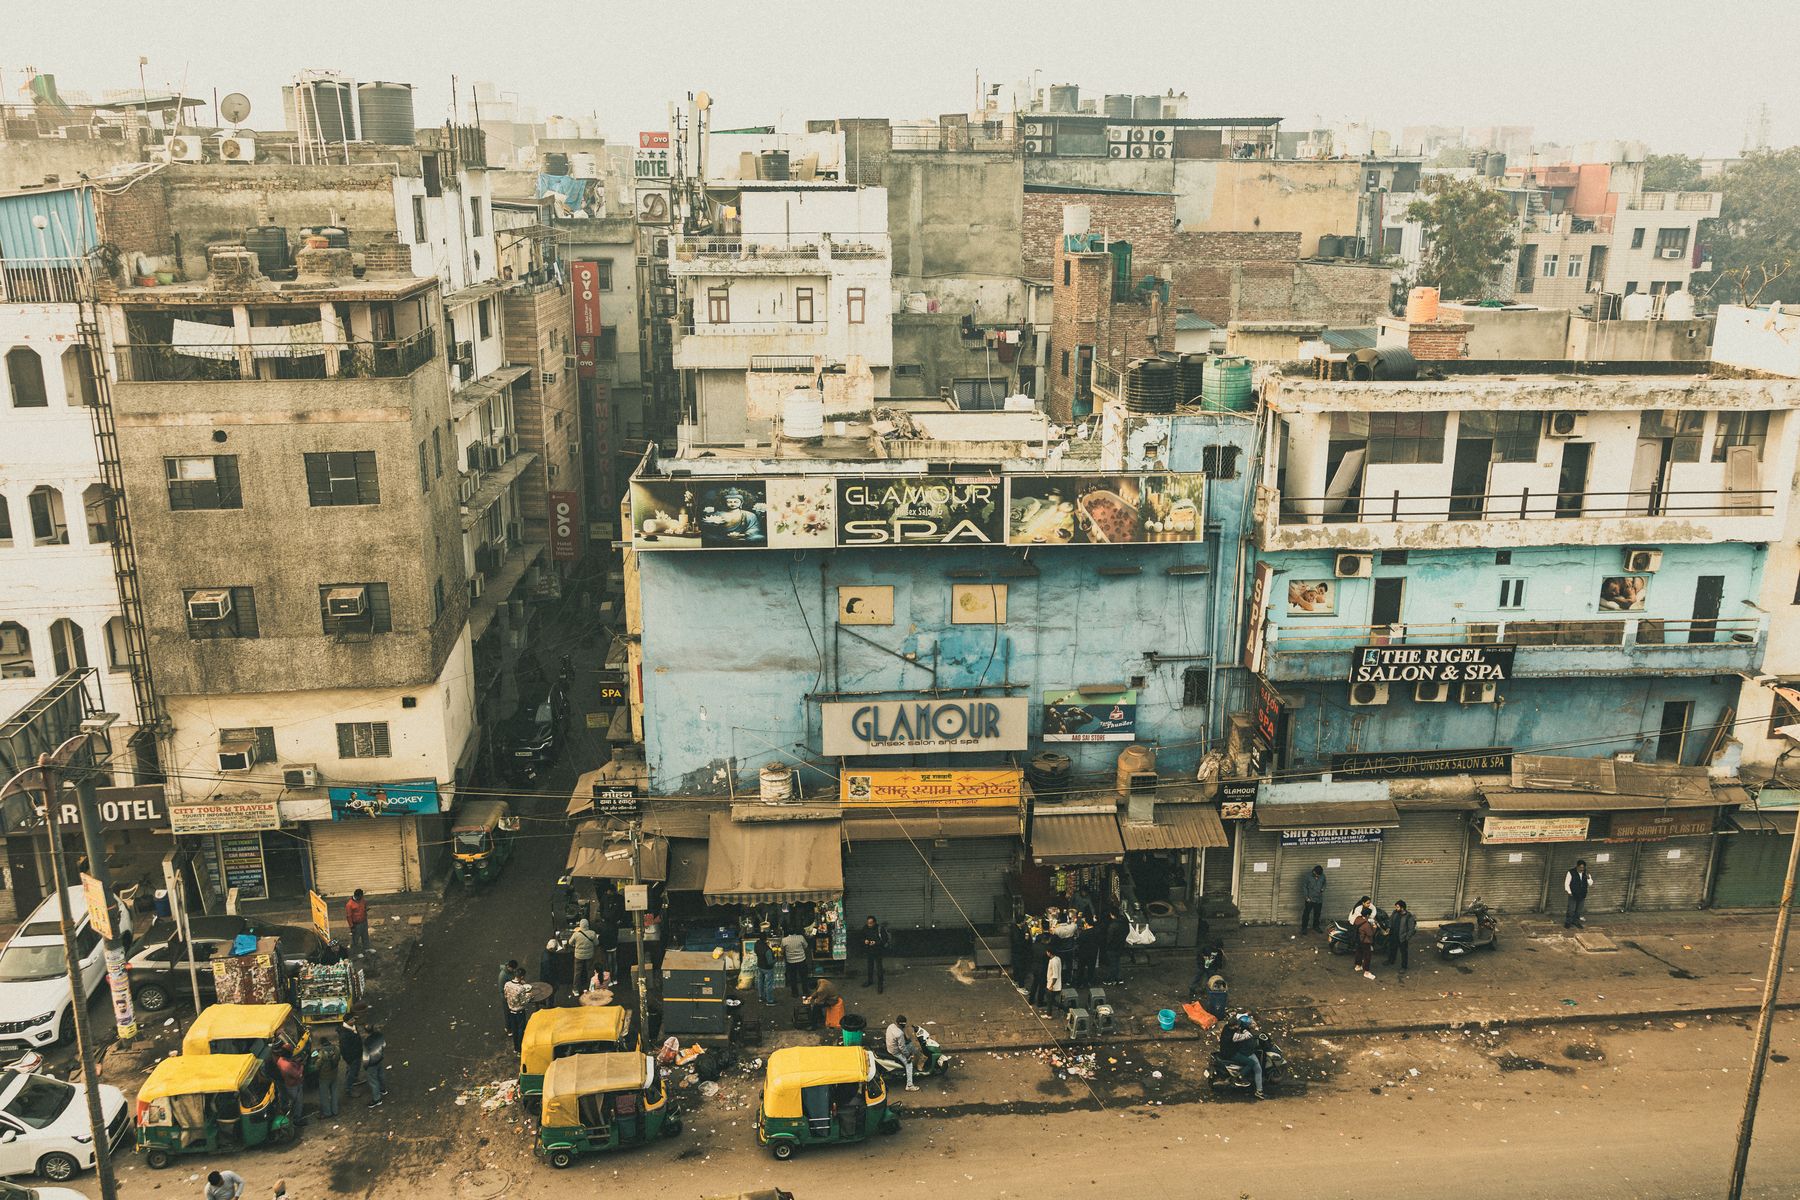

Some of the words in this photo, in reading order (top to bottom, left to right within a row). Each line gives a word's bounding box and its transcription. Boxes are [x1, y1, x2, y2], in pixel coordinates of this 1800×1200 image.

[635, 160, 670, 177] HOTEL
[581, 270, 593, 300] OYO
[845, 485, 991, 505] GLAMOUR
[557, 503, 571, 537] OYO
[844, 519, 991, 543] SPA
[1246, 579, 1262, 654] SPA
[1381, 650, 1422, 664] THE
[1425, 648, 1486, 664] RIGEL
[1357, 665, 1437, 682] SALON
[1440, 665, 1459, 681] &
[1464, 664, 1505, 681] SPA
[602, 689, 622, 698] SPA
[1261, 687, 1279, 714] SALON
[851, 703, 1001, 742] GLAMOUR
[1259, 708, 1274, 737] SPA
[871, 740, 905, 748] unisex
[908, 739, 936, 747] salon
[938, 738, 958, 746] and
[1342, 755, 1417, 775] GLAMOUR
[1420, 760, 1450, 771] UNISEX
[1452, 758, 1479, 769] SALON
[1481, 758, 1488, 768] &
[1490, 756, 1504, 768] SPA
[912, 784, 953, 795] श्याम
[174, 807, 195, 815] CITY
[197, 806, 222, 814] TOUR
[233, 804, 273, 812] TRAVELS
[1283, 829, 1308, 839] SHIV
[1310, 829, 1348, 837] SHAKTI
[1351, 827, 1382, 835] SALES
[1669, 823, 1706, 834] PLASTIC
